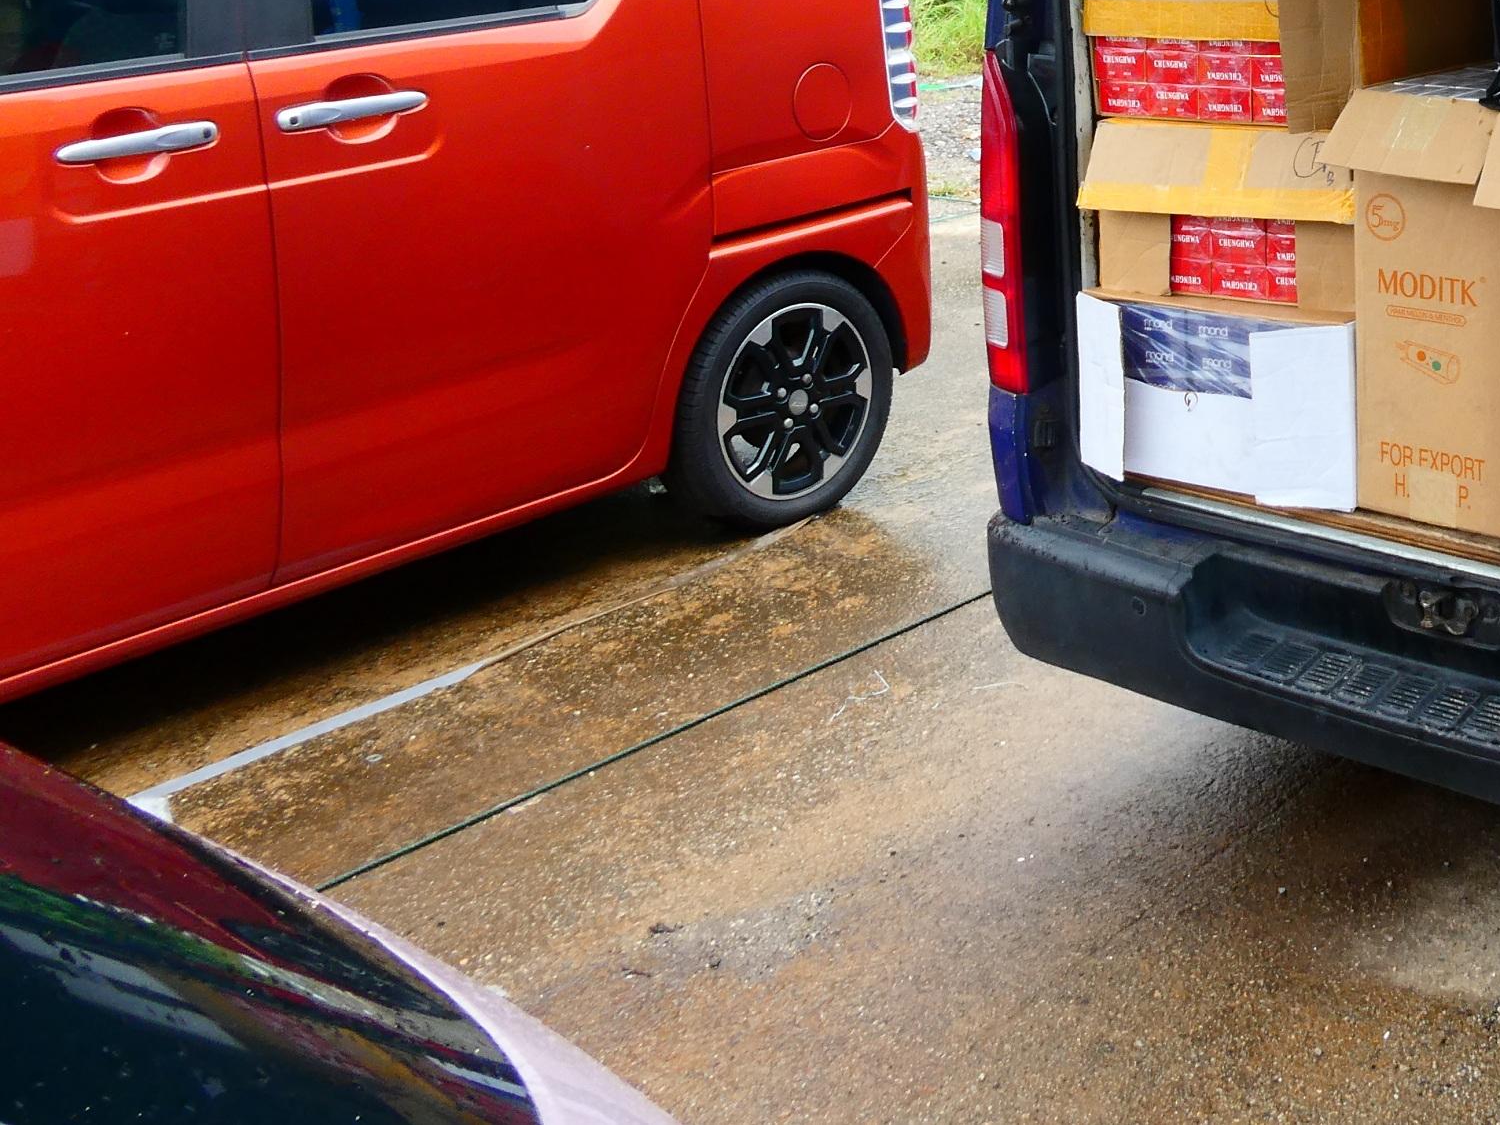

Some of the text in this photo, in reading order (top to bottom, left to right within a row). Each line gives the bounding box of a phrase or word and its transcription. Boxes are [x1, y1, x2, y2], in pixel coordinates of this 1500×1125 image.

[1207, 71, 1242, 81] CHUNGHWA
[1208, 103, 1242, 112] CHUNGHWA
[1371, 204, 1400, 232] 5mg
[1219, 238, 1255, 248] CHUNGHWA
[1222, 280, 1257, 290] CHUNGHWA
[1378, 267, 1477, 307] MODITK
[1381, 442, 1485, 481] FOR EXPORT
